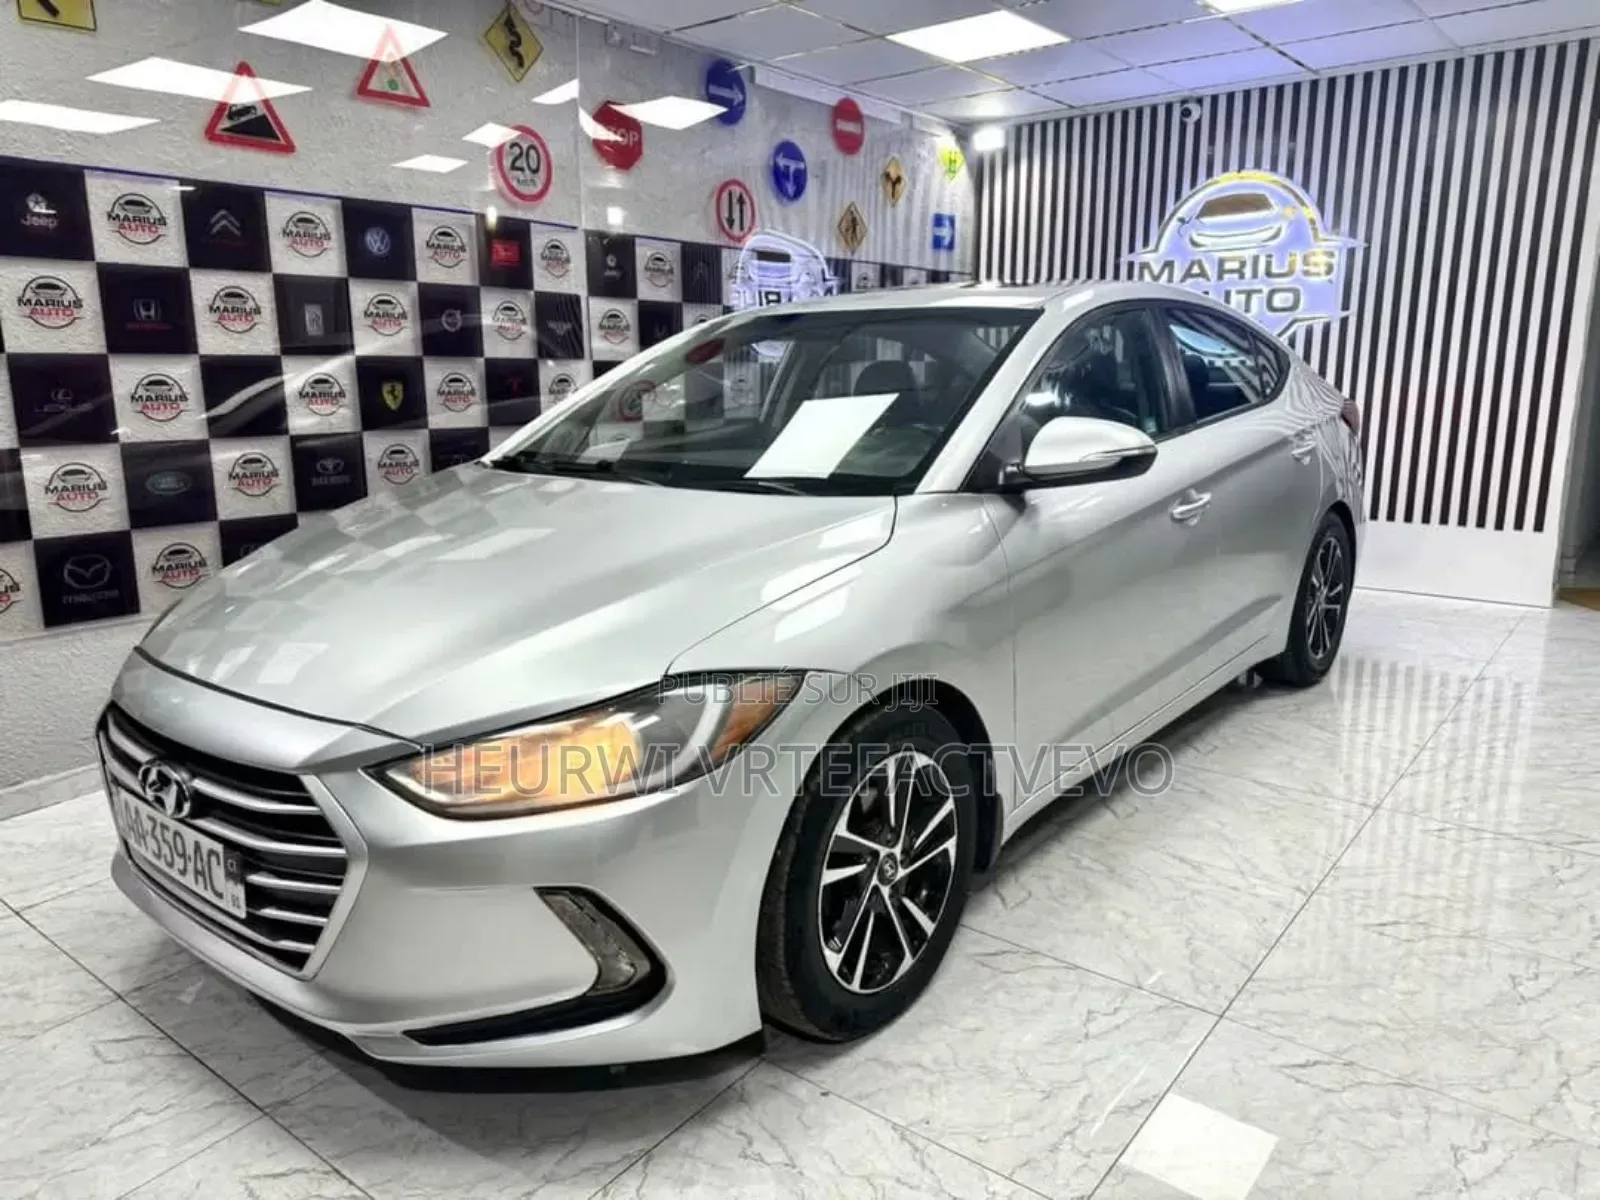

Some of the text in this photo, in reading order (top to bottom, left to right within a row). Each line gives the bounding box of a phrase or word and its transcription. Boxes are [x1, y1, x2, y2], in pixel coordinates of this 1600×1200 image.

[509, 141, 541, 175] 20
[21, 214, 59, 229] Jeep
[107, 212, 167, 226] MARIUS
[118, 223, 160, 234] AUTO
[282, 228, 331, 241] MARIUS
[290, 236, 325, 248] AUTO
[426, 241, 467, 253] MARIUS
[432, 250, 460, 260] AUTO
[1137, 250, 1336, 285] MARIUS
[18, 298, 83, 309] MARIUS
[28, 307, 75, 319] AUTO
[209, 304, 262, 316] MARIUS
[364, 310, 408, 321] MARIUS
[217, 313, 255, 324] AUTO
[371, 319, 402, 329] AUTO
[131, 392, 190, 403] MARIUS
[140, 401, 182, 412] AUTO
[228, 469, 279, 482] MARIUS
[45, 483, 108, 495] MARIUS
[236, 478, 272, 489] AUTO
[56, 490, 100, 502] AUTO
[152, 559, 208, 574] MARIUS
